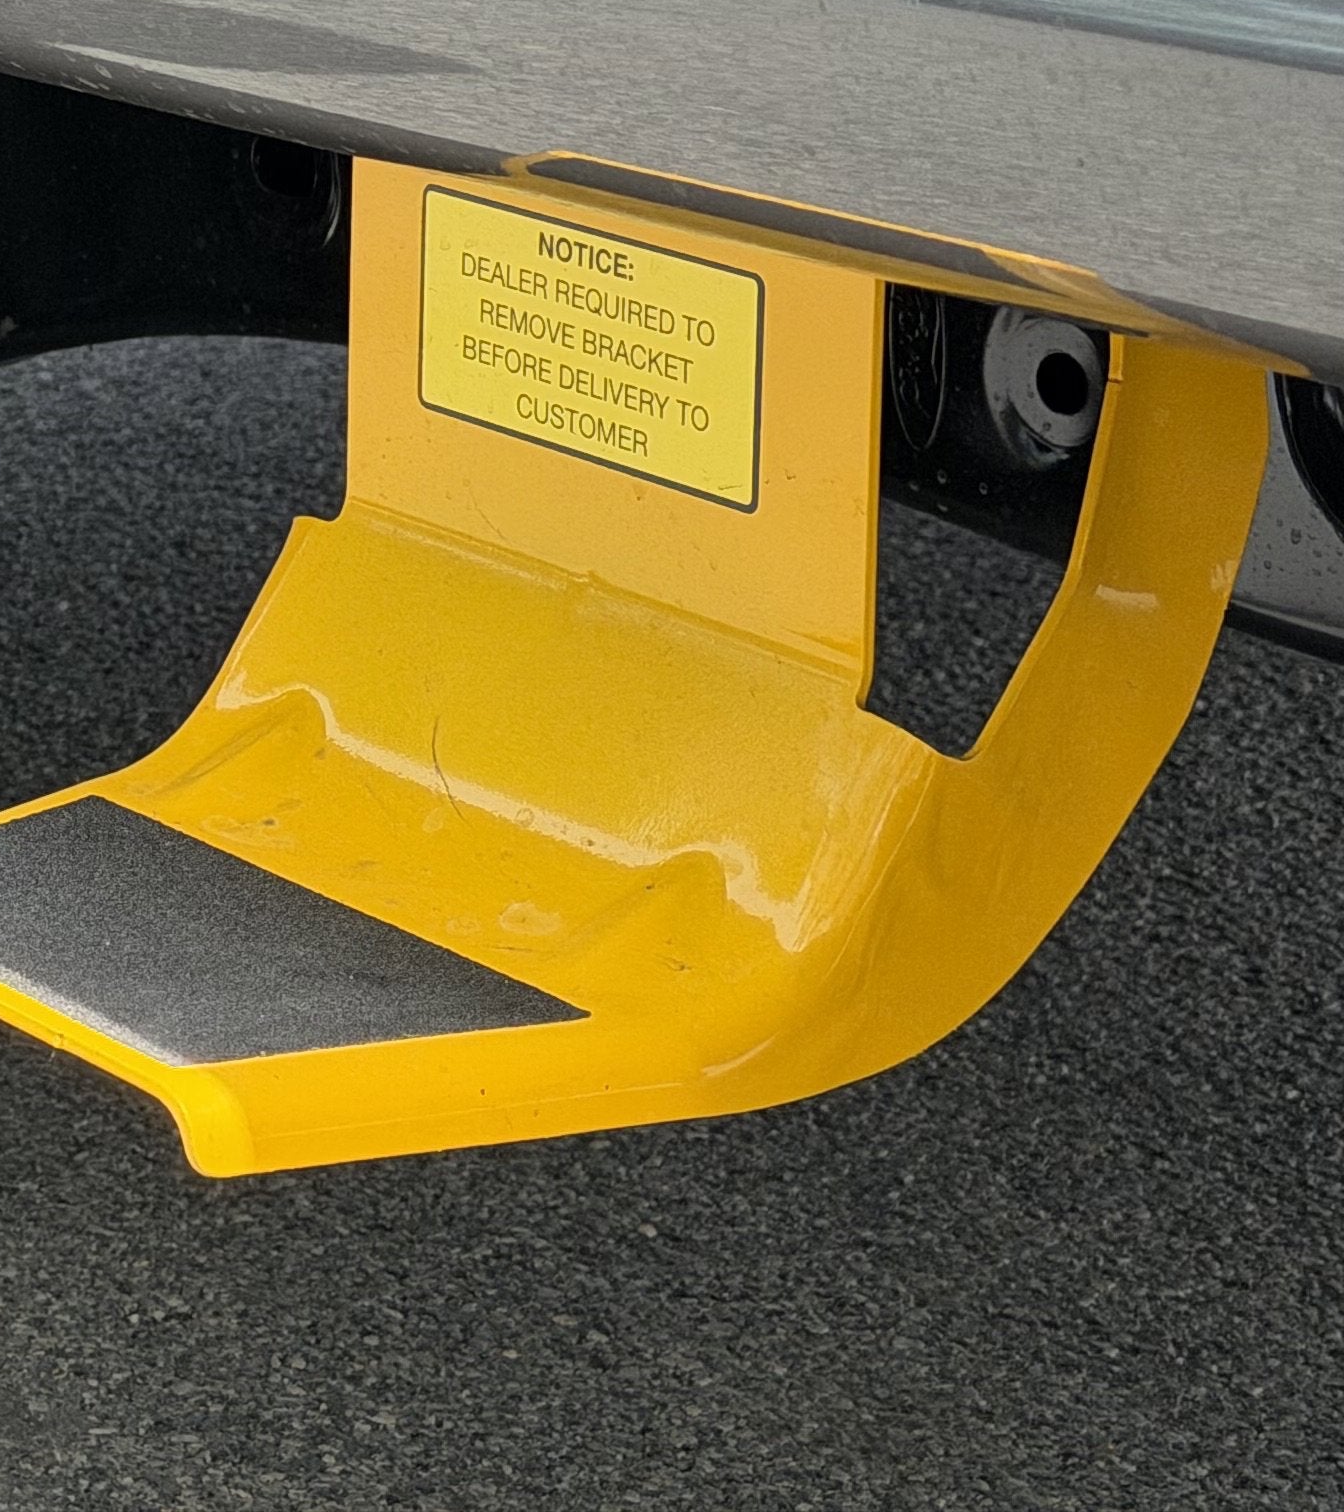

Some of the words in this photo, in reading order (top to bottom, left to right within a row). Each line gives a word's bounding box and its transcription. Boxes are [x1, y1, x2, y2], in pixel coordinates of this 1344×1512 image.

[461, 251, 548, 300] DEALER
[555, 278, 676, 335] REQUIRED
[682, 314, 715, 347] TO
[538, 231, 635, 282] NOTICE:
[462, 334, 552, 385] BEFORE
[559, 363, 670, 420] DELIVERY
[676, 399, 710, 432] TO
[479, 298, 576, 350] REMOVE
[582, 329, 694, 385] BRACKET
[515, 392, 649, 458] CUSTOMER
